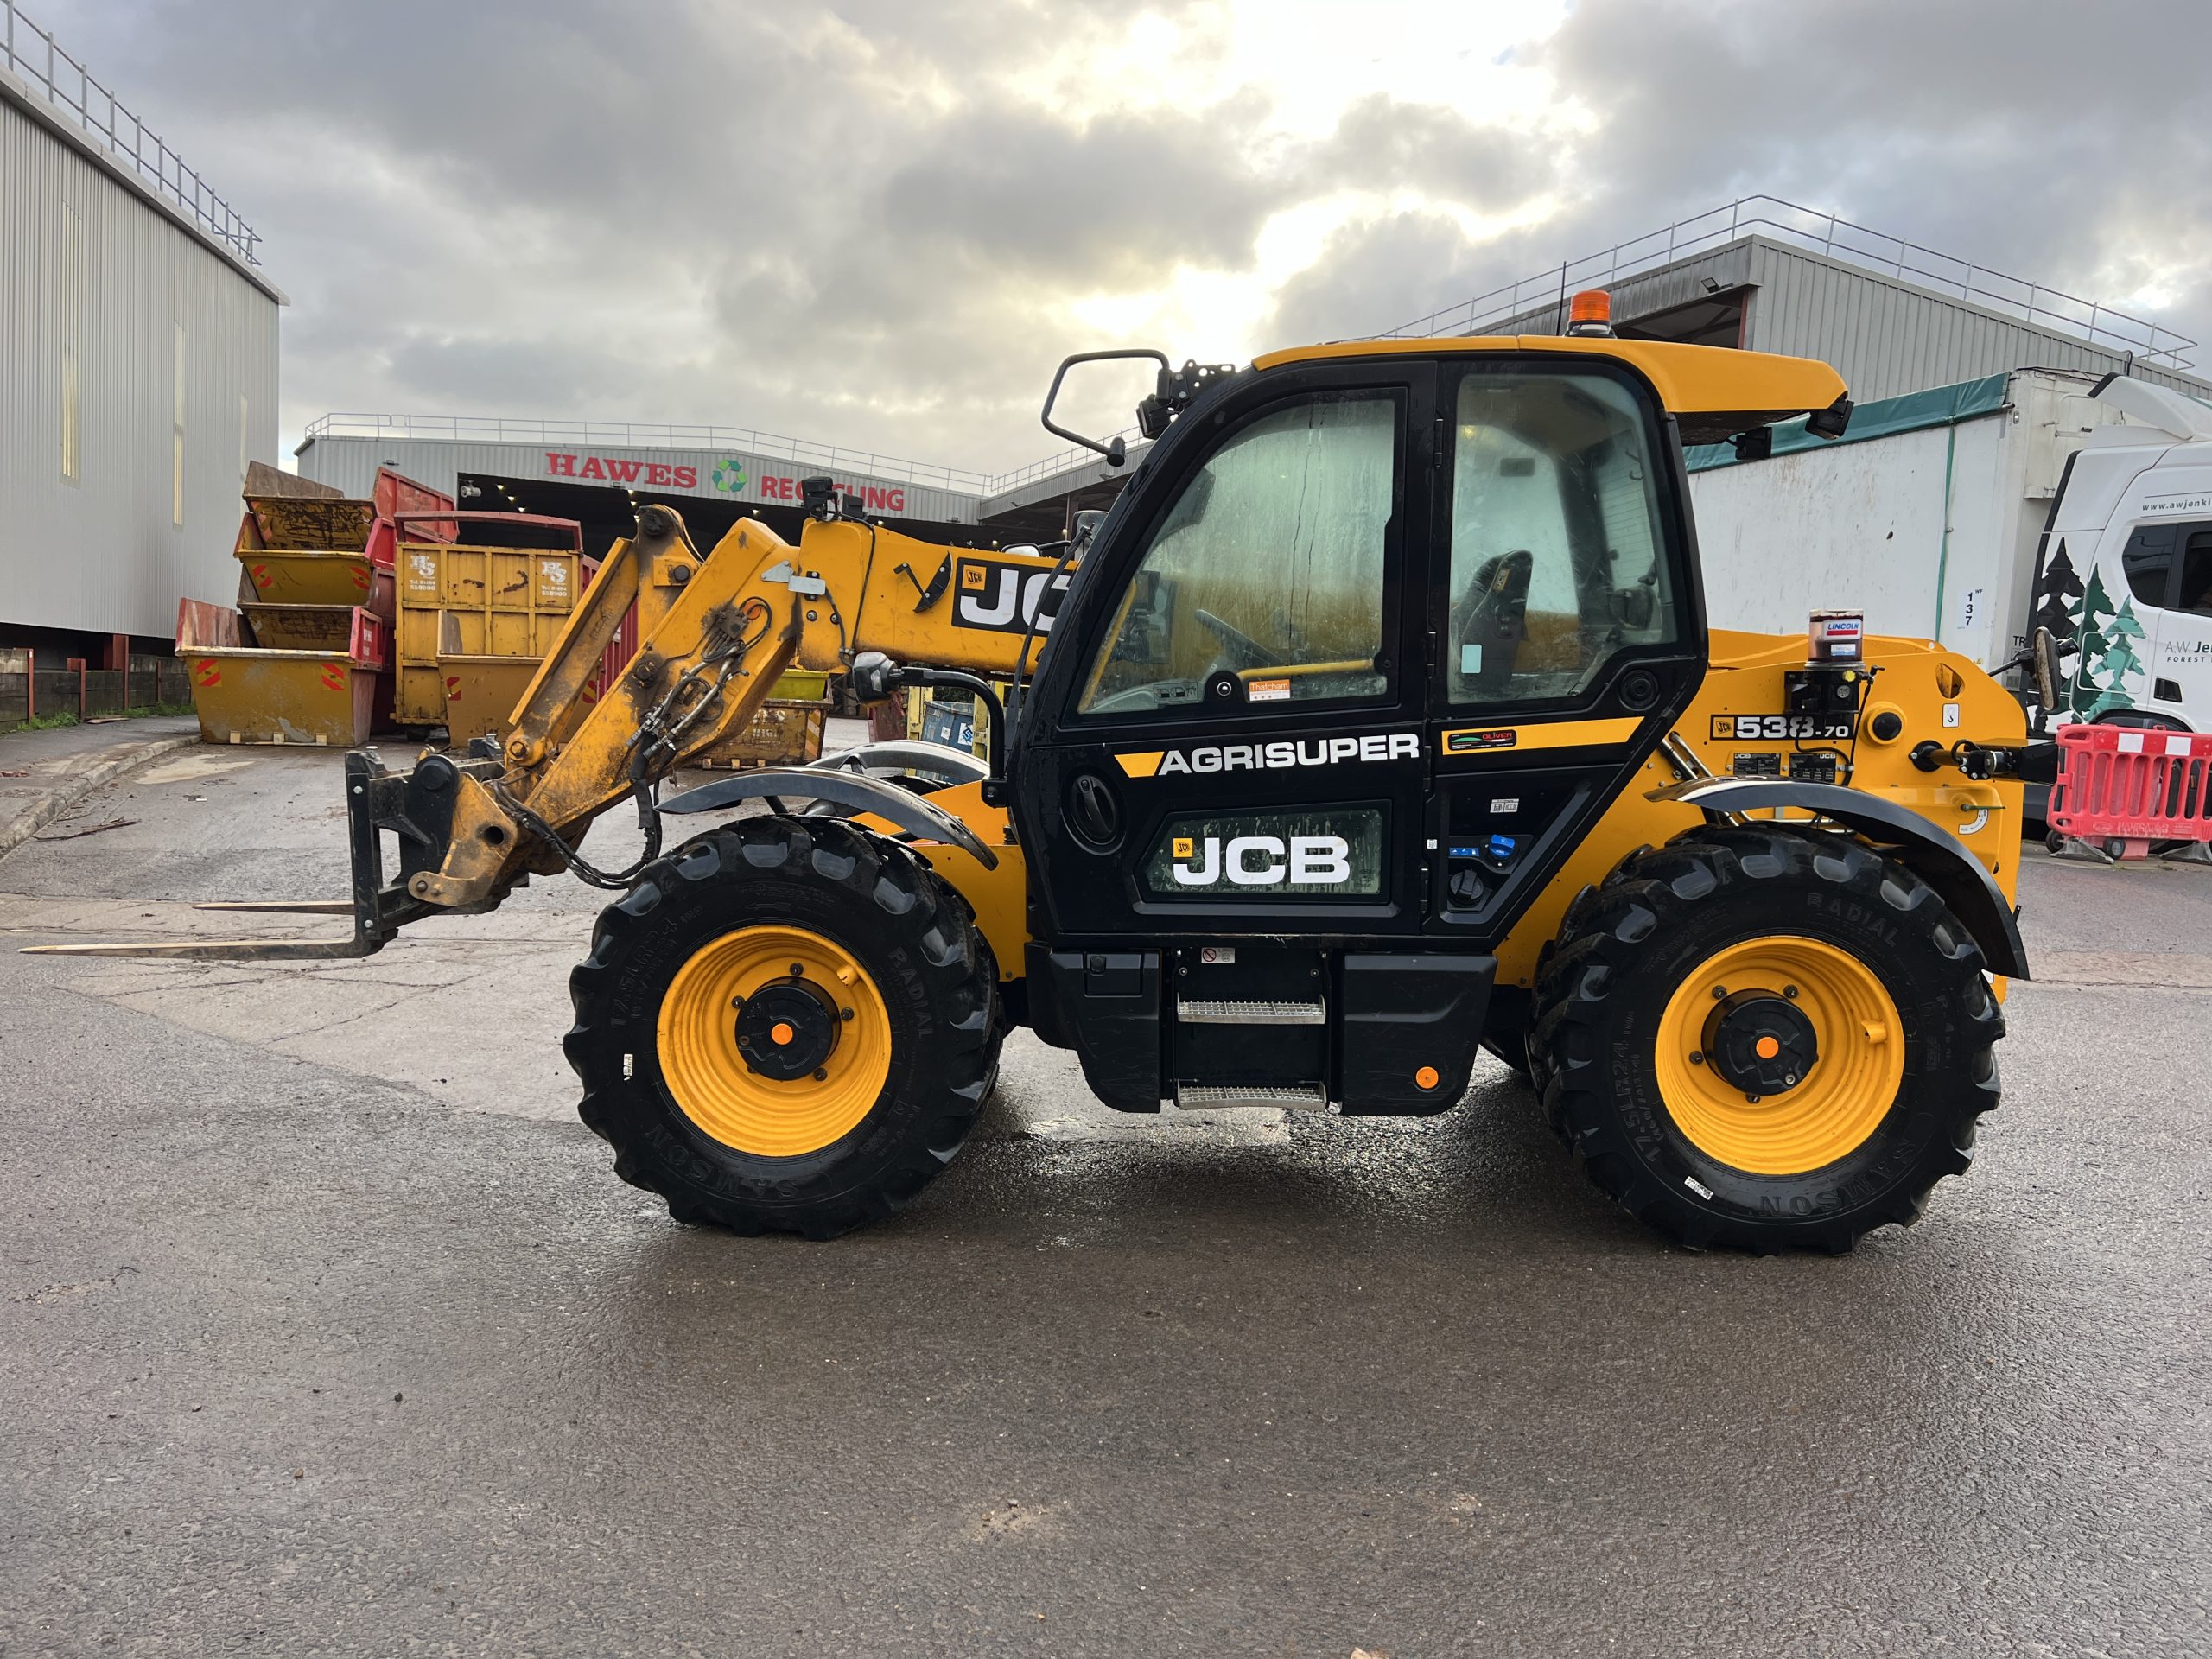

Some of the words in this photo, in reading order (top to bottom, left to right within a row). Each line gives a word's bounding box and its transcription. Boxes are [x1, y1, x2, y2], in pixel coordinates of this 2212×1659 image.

[545, 453, 697, 488] HAWES
[2143, 498, 2211, 511] www.awjenki
[960, 569, 1071, 632] JC
[2194, 641, 2212, 653] Je
[1251, 682, 1288, 691] Thatcham
[1158, 733, 1420, 777] AGRISUPER
[1173, 836, 1351, 885] JCB
[1807, 892, 1899, 948] RADIAL
[887, 946, 934, 1039] RADIAL
[1759, 1138, 1916, 1217] SAMSON
